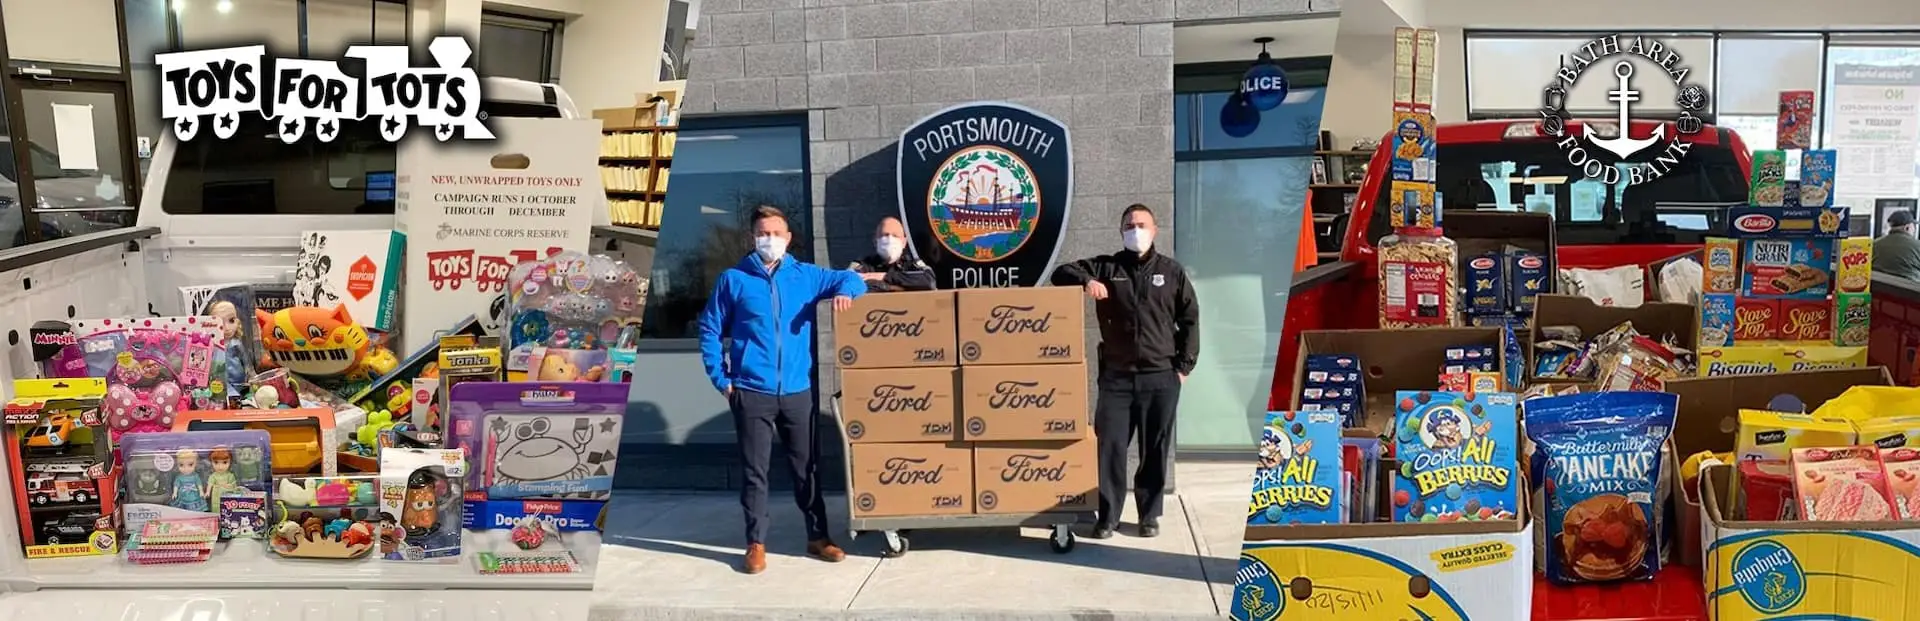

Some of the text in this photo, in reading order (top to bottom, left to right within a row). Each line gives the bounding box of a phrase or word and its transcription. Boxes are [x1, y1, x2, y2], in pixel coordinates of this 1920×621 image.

[1240, 76, 1282, 94] OLICE
[913, 116, 1055, 161] PORTSMOUTH
[431, 175, 582, 187] NEW, UNWRAPPED TOYS ONLY
[434, 193, 491, 203] CAMPAIGN
[491, 194, 518, 204] RUNS
[527, 195, 577, 204] OCTOBER
[444, 206, 566, 217] THROUGH DECEMBER
[453, 228, 569, 239] MARINE CORPS RESERVE
[1755, 243, 1789, 254] NUTRI
[1755, 253, 1788, 262] GRAIN
[431, 256, 509, 281] TOYS FOR
[1842, 251, 1869, 270] POPS
[953, 267, 1019, 288] POLICE
[383, 289, 396, 329] SUSPICION
[984, 304, 1051, 334] Ford
[860, 309, 926, 338] Ford
[1782, 308, 1828, 335] Stove
[34, 331, 78, 345] MINNIE
[447, 354, 490, 366] Tonka
[867, 384, 932, 413] Ford
[989, 380, 1056, 410] Ford
[1462, 436, 1495, 464] All
[878, 456, 943, 485] Ford
[1001, 453, 1067, 482] Ford
[1282, 455, 1317, 484] All
[518, 481, 589, 494] Stamping Fun!
[1415, 464, 1510, 496] BERRIES
[1589, 480, 1625, 493] MIX
[29, 548, 48, 556] FIRE
[59, 546, 91, 554] RESCUE
[1441, 542, 1503, 560] CLASS EXTRA
[1734, 548, 1793, 585] Chiquita
